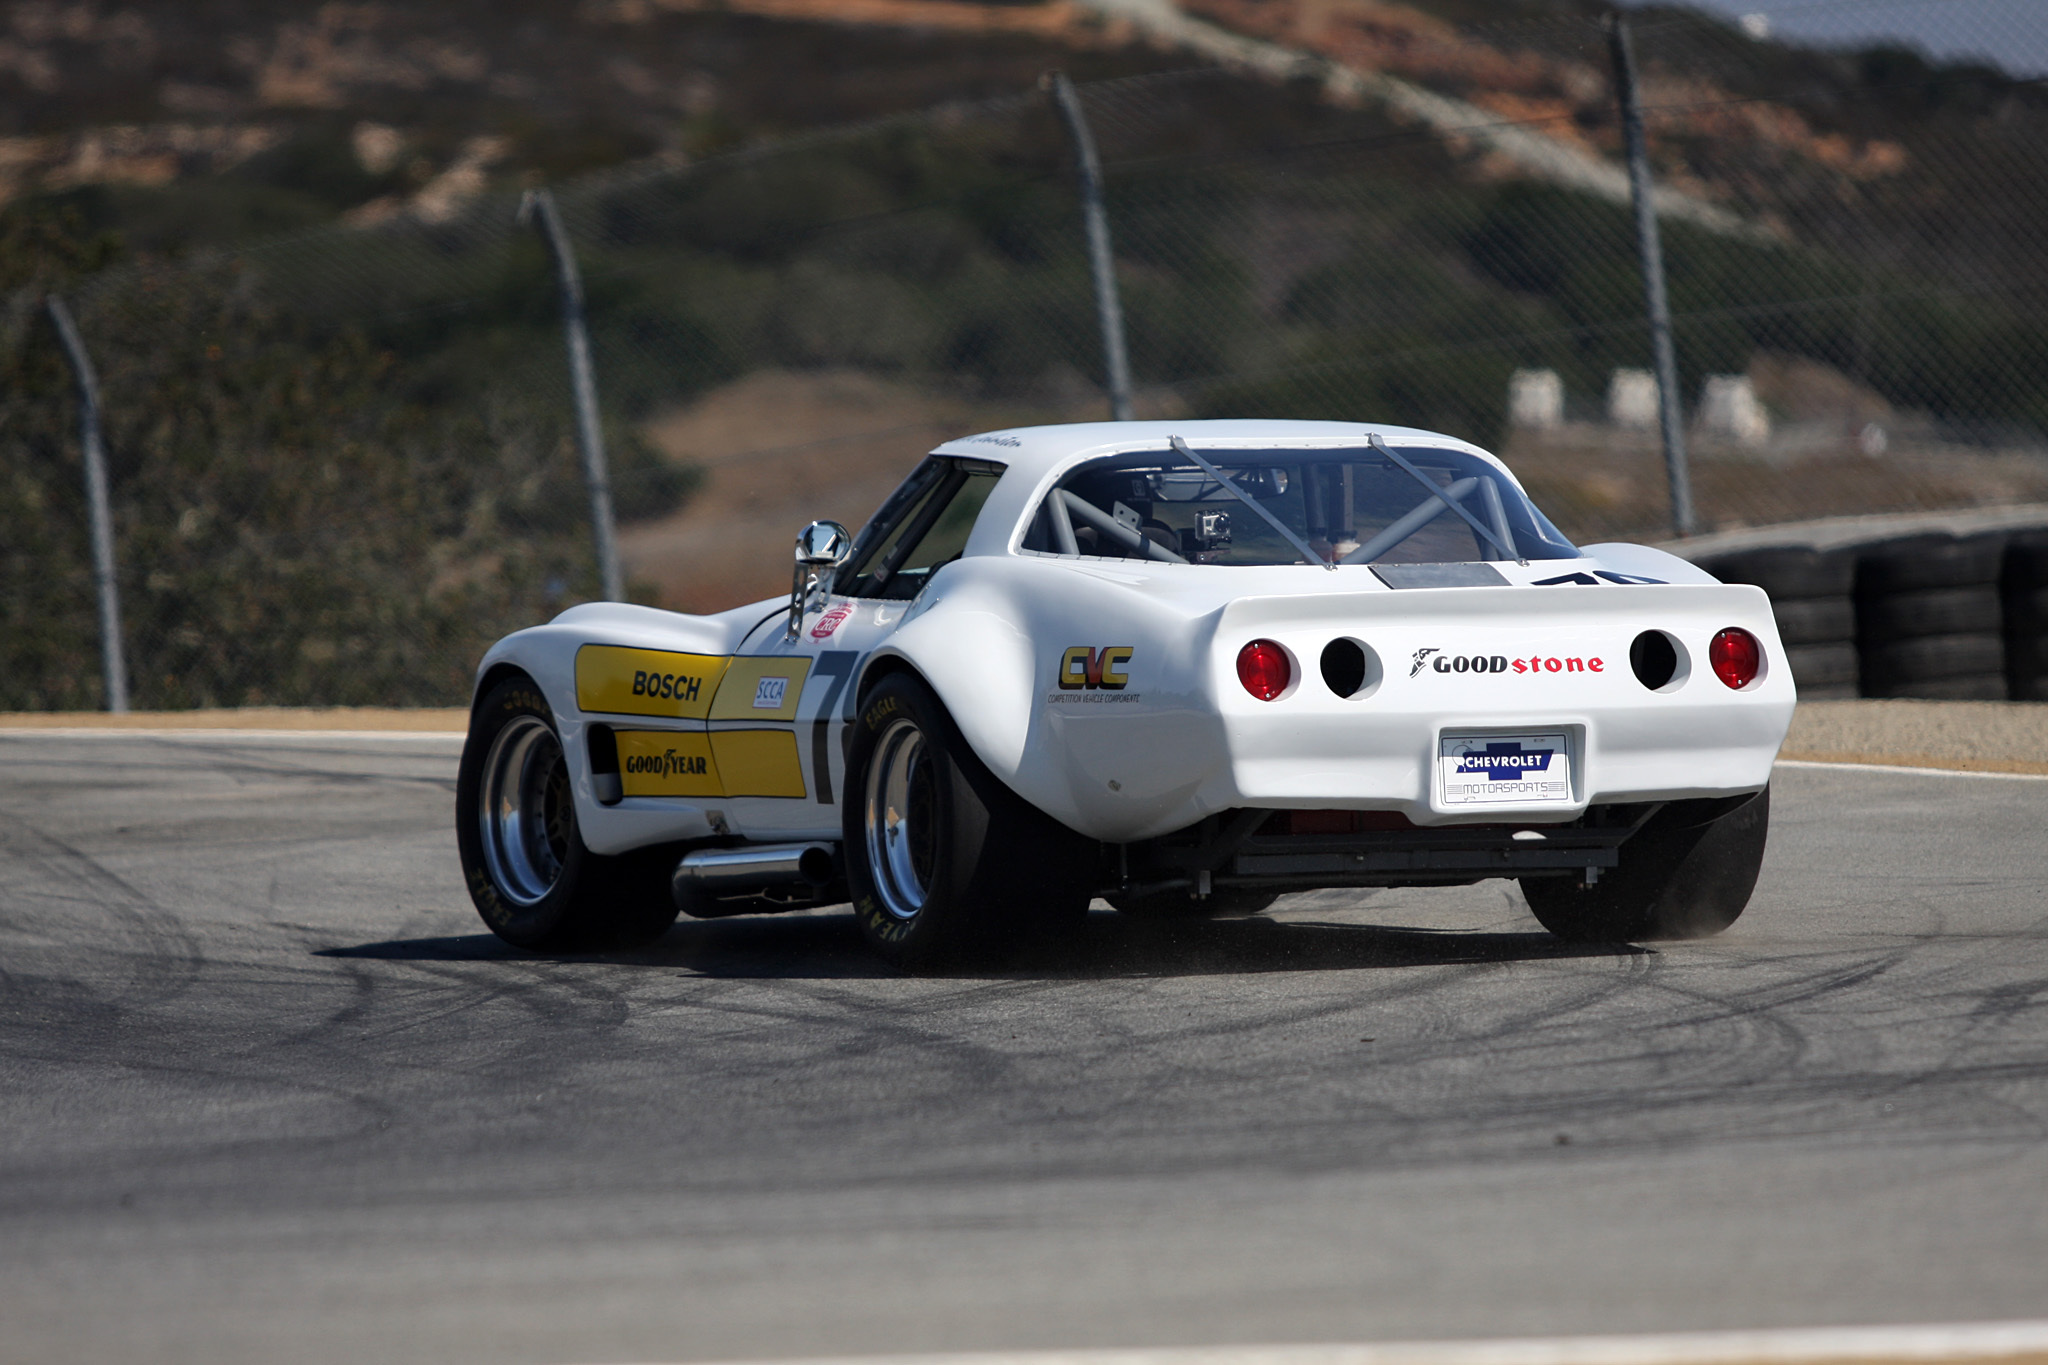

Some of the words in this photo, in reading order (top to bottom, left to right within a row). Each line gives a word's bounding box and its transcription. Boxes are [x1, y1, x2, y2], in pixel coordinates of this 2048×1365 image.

[814, 617, 841, 631] CRC
[1058, 646, 1134, 690] CVC
[632, 670, 703, 702] BOSCH
[756, 680, 784, 699] SCCA
[1047, 693, 1082, 704] COMPETITION
[1082, 693, 1103, 704] VEHICLE
[1104, 693, 1140, 704] COMPONENTS
[865, 696, 897, 731] EAGLE
[626, 750, 708, 778] GOODYEAR
[1465, 755, 1542, 769] CHEVROLET
[1463, 781, 1548, 796] MOTORSPORTS
